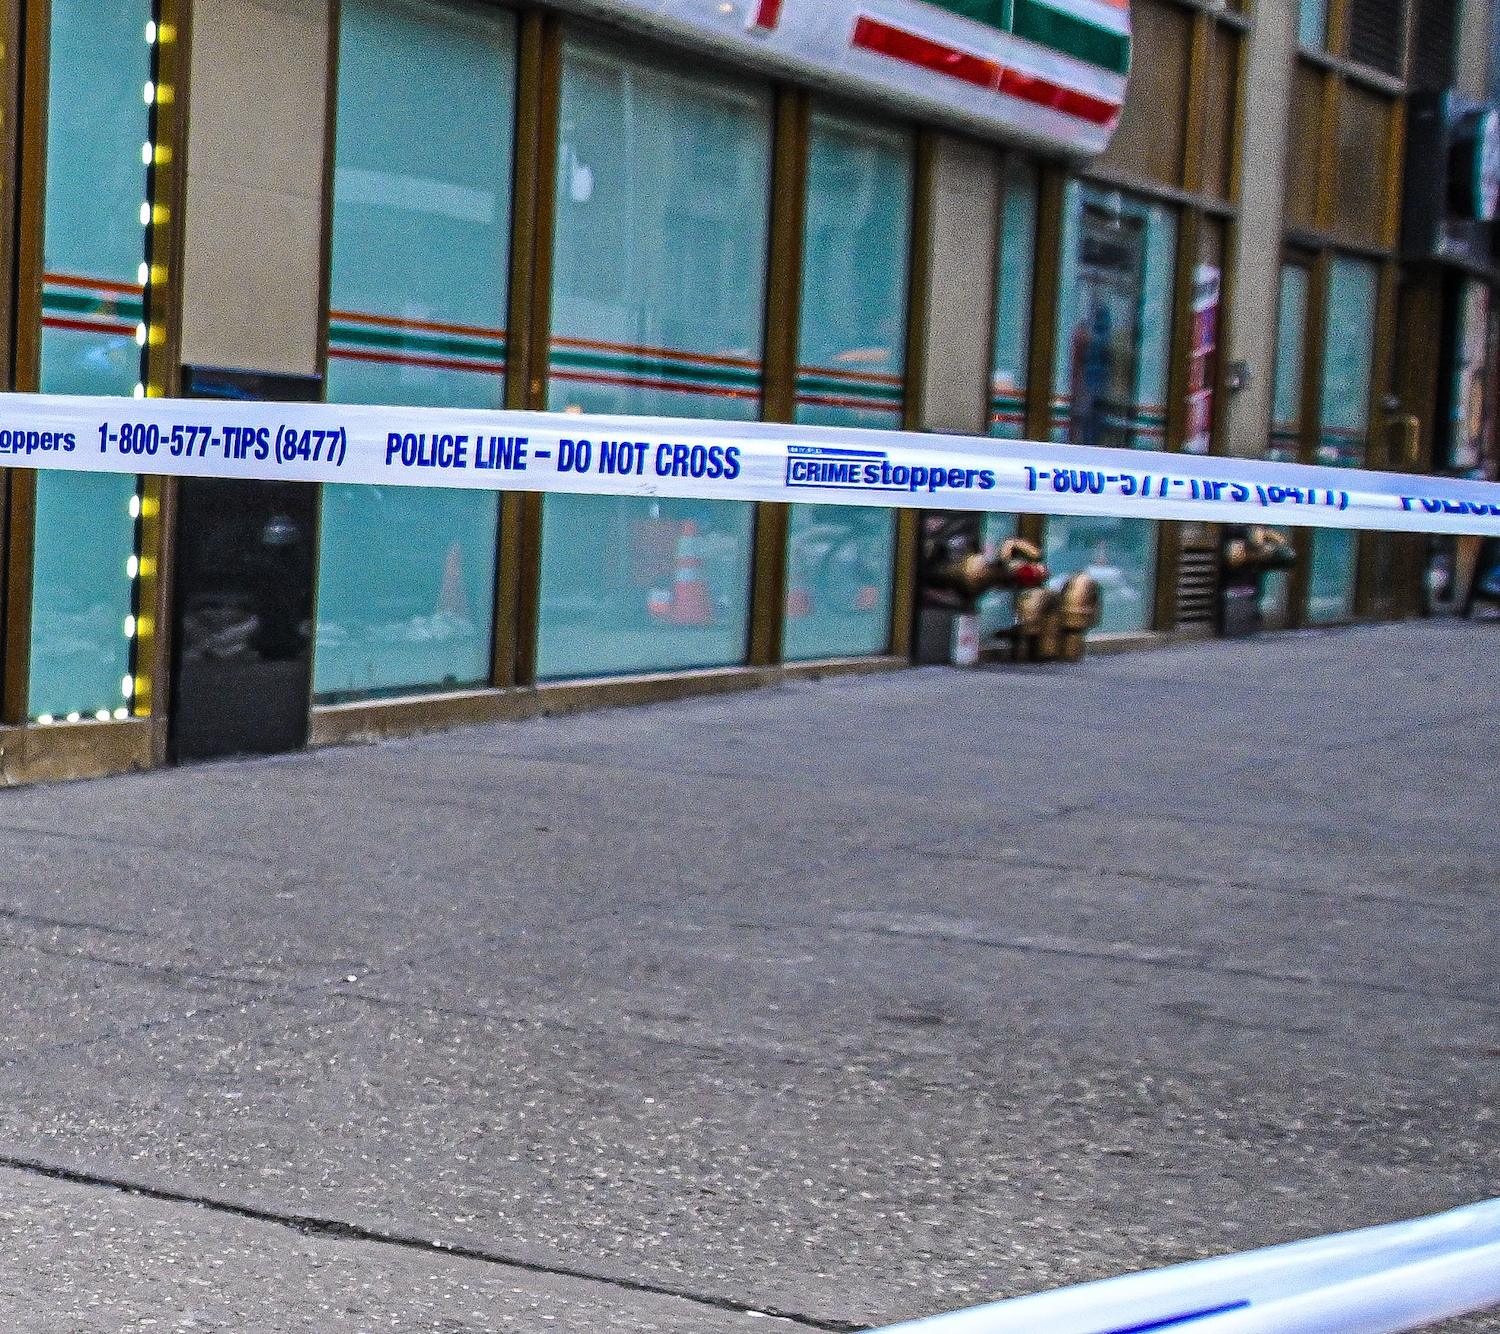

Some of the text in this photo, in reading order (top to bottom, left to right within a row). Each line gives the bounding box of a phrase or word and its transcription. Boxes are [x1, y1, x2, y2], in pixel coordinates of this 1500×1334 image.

[98, 421, 269, 461] 1-800-577-TIPS
[275, 424, 347, 467] (8477)
[385, 431, 467, 470] POLICE
[474, 436, 528, 472] LINE
[557, 438, 592, 474] DO
[599, 440, 649, 476] NOT
[655, 442, 741, 481] CROSS
